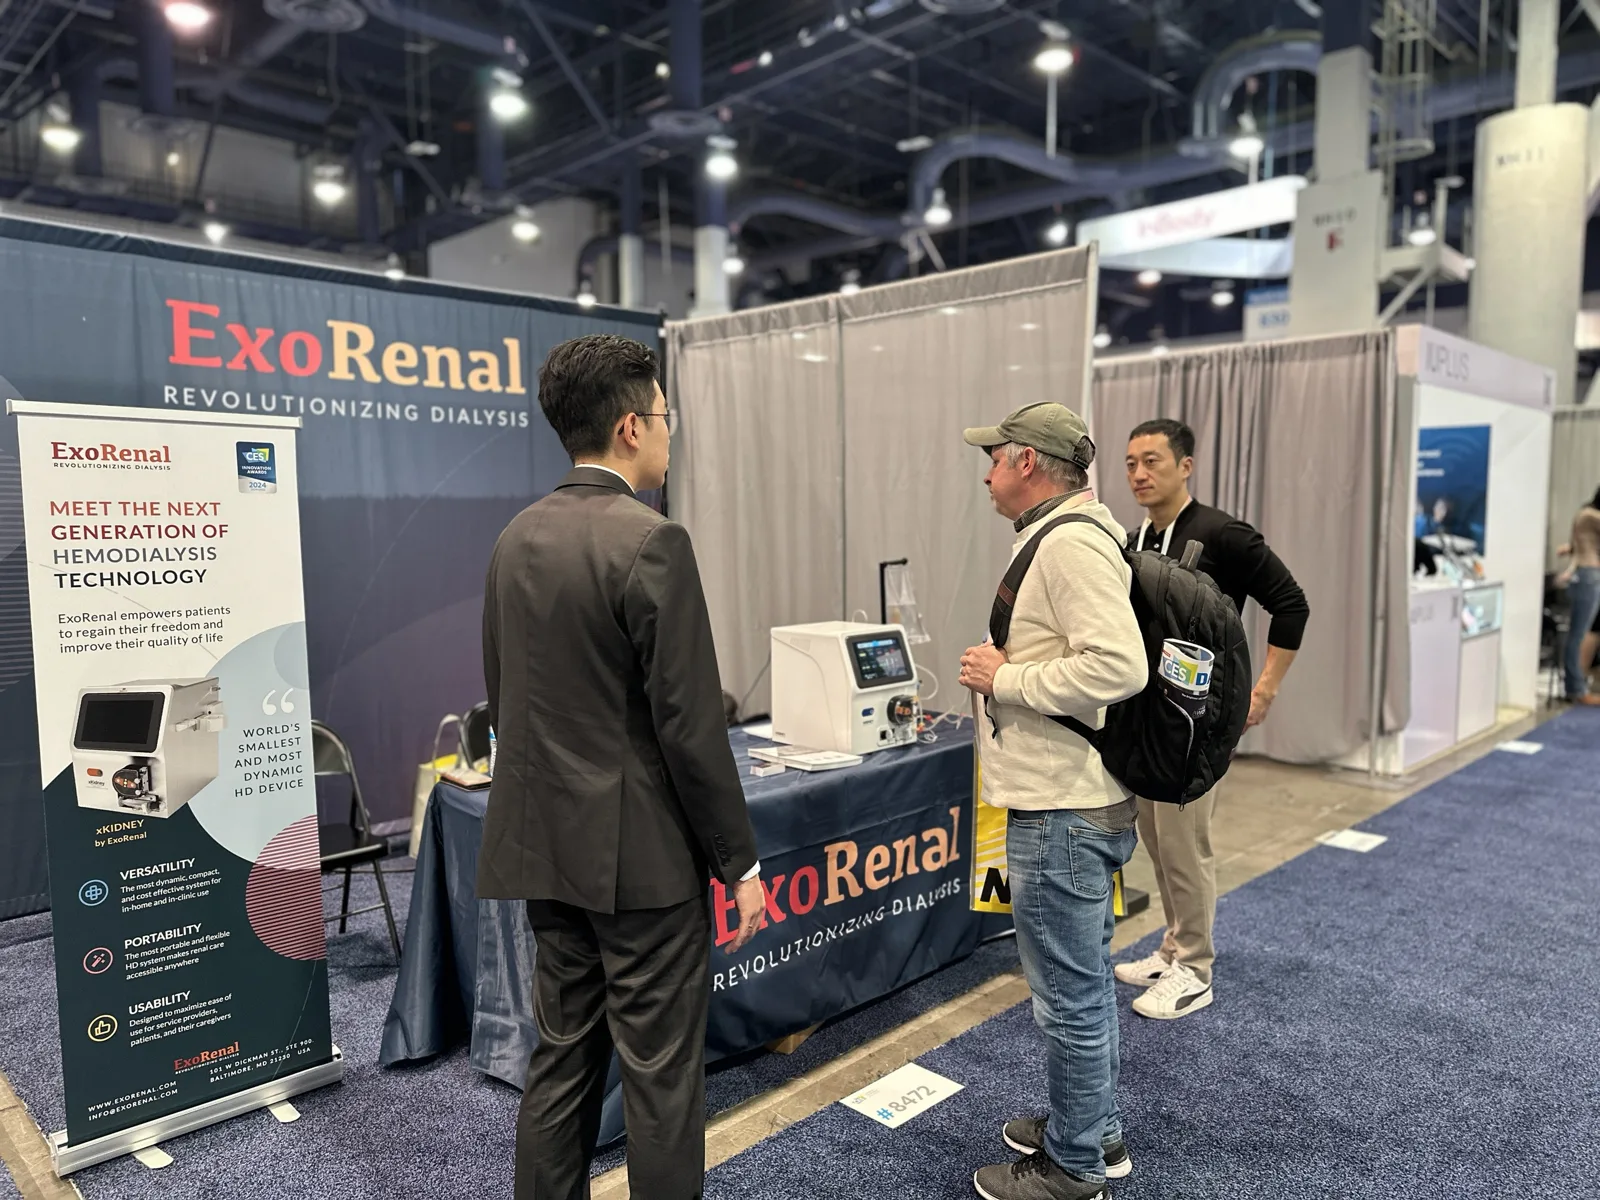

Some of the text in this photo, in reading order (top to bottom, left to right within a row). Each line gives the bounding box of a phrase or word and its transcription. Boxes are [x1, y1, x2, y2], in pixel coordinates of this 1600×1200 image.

[166, 299, 526, 394] ExoRenal
[164, 385, 529, 428] REVOLUTIONIZING DIALYSIS
[51, 442, 171, 463] ExoRenal
[246, 452, 264, 461] CES
[50, 501, 221, 516] MEET THE NEXT
[52, 524, 228, 540] GENERATION OF
[54, 547, 217, 564] HEMODIALYSIS
[54, 569, 207, 588] TECHNOLOGY
[58, 606, 231, 624] ExoRenal empowers patients
[59, 619, 223, 639] to regain their freedom and
[60, 633, 223, 654] improve their quality of life
[1164, 660, 1187, 682] CES
[243, 723, 300, 737] WORLD'S
[238, 737, 301, 753] SMALLEST
[234, 751, 302, 768] AND MOST
[244, 765, 303, 781] DYNAMIC
[235, 779, 303, 797] HD DEVICE
[96, 819, 144, 835] xKIDNEY
[107, 832, 147, 844] ExoRenal
[120, 858, 195, 880] VERSATILITY
[136, 882, 155, 890] most
[156, 875, 188, 887] dynamic,
[188, 868, 220, 879] compact,
[710, 806, 960, 948] ExoRenal
[121, 895, 135, 903] and
[136, 891, 152, 900] cost
[153, 886, 185, 897] effective
[186, 880, 210, 890] system
[122, 901, 152, 913] in-home
[154, 898, 167, 906] and
[168, 892, 196, 903] in-clinic
[124, 923, 202, 949] PORTABILITY
[125, 931, 230, 960] The most portable and flexible
[713, 906, 885, 992] REVOLUTIONIZING
[892, 877, 961, 915] DIALYSIS
[126, 942, 224, 970] HD system makes renal care
[126, 957, 199, 980] accessible anywhere
[128, 990, 190, 1015] USABILITY
[130, 1012, 164, 1027] Designed
[174, 1002, 207, 1014] maximize
[208, 997, 224, 1006] ease
[130, 1028, 143, 1036] use
[156, 1018, 182, 1030] service
[183, 1008, 218, 1022] providers,
[130, 1013, 231, 1047] patients, and their caregivers
[174, 1042, 240, 1070] ExoRenal
[209, 1066, 222, 1074] 101
[235, 1052, 268, 1067] DICKMAN
[286, 1043, 298, 1051] STE
[210, 1066, 254, 1083] BALTIMORE,
[270, 1053, 290, 1064] 21230
[298, 1047, 311, 1055] USA
[88, 1080, 177, 1112] WWW.EXORENAL.COM
[88, 1088, 178, 1121] INFO@EXORENAL.COM
[877, 1085, 937, 1120] #8472
